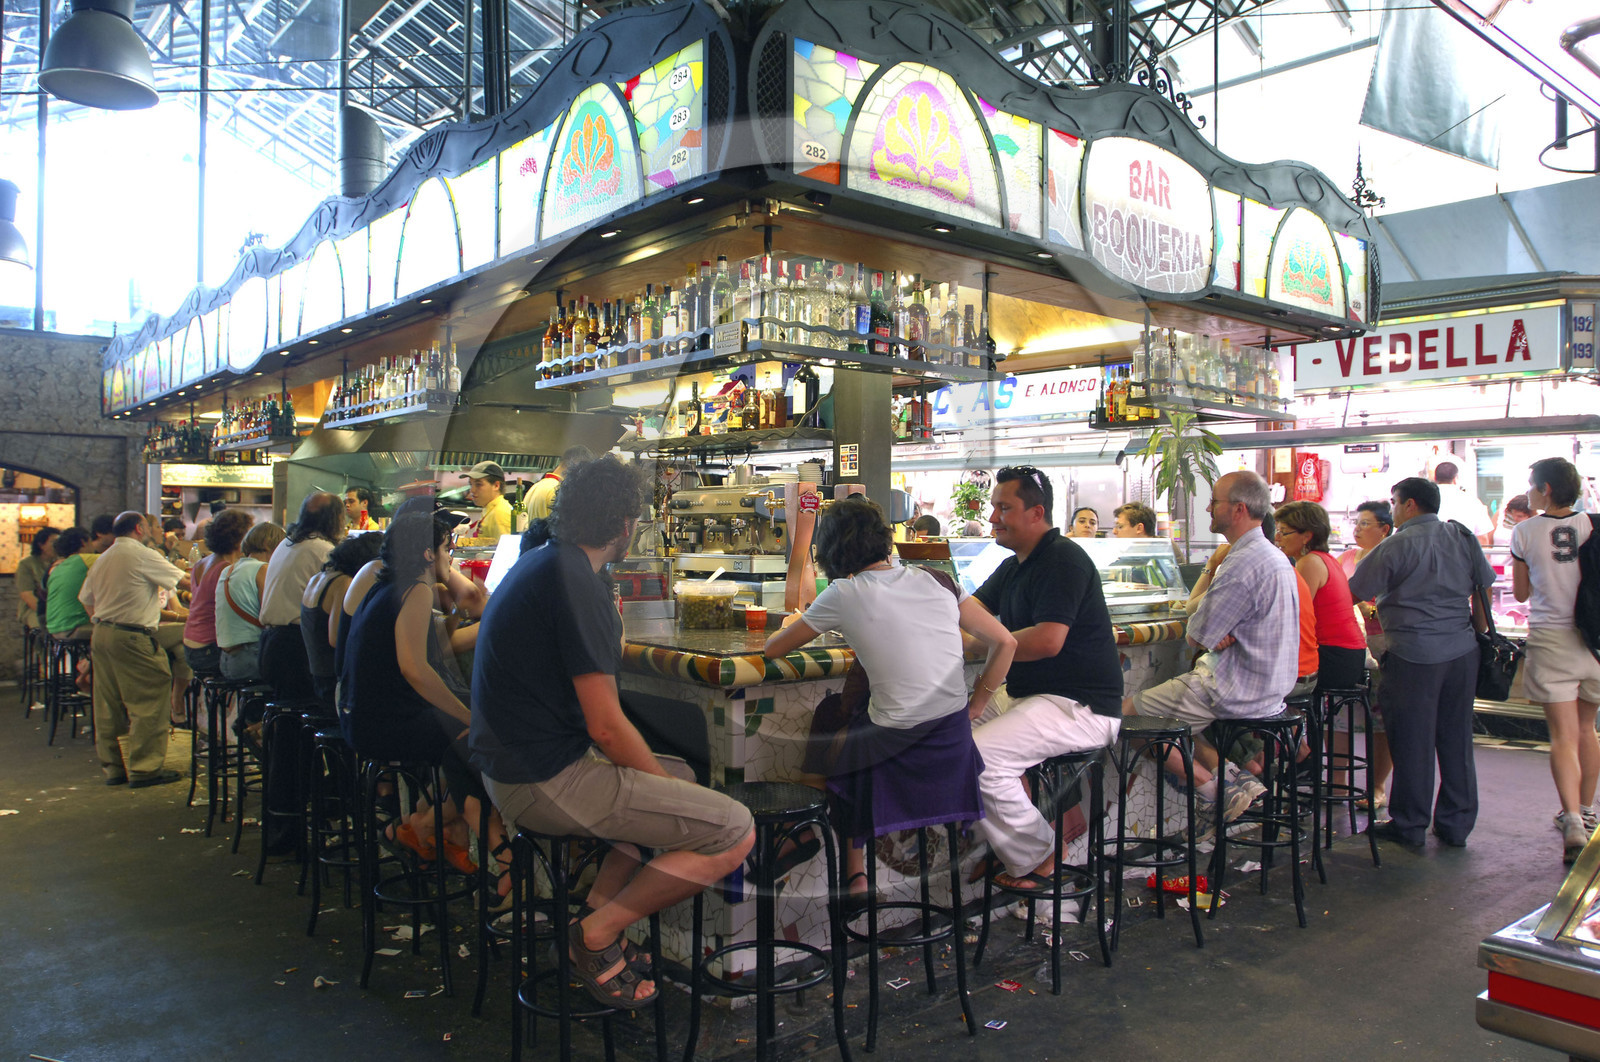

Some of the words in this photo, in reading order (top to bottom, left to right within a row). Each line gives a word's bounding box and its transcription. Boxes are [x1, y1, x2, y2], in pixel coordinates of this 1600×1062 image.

[673, 70, 689, 86] 284
[671, 110, 688, 127] 283
[671, 150, 687, 166] 282
[804, 144, 827, 161] 282
[1129, 159, 1171, 210] BAR
[1093, 203, 1204, 272] BOQUERIA
[1573, 315, 1594, 332] 192
[1335, 318, 1532, 378] VEDELLA
[1573, 342, 1593, 360] 193
[1040, 378, 1097, 396] ALONSO
[1550, 525, 1579, 564] 9
